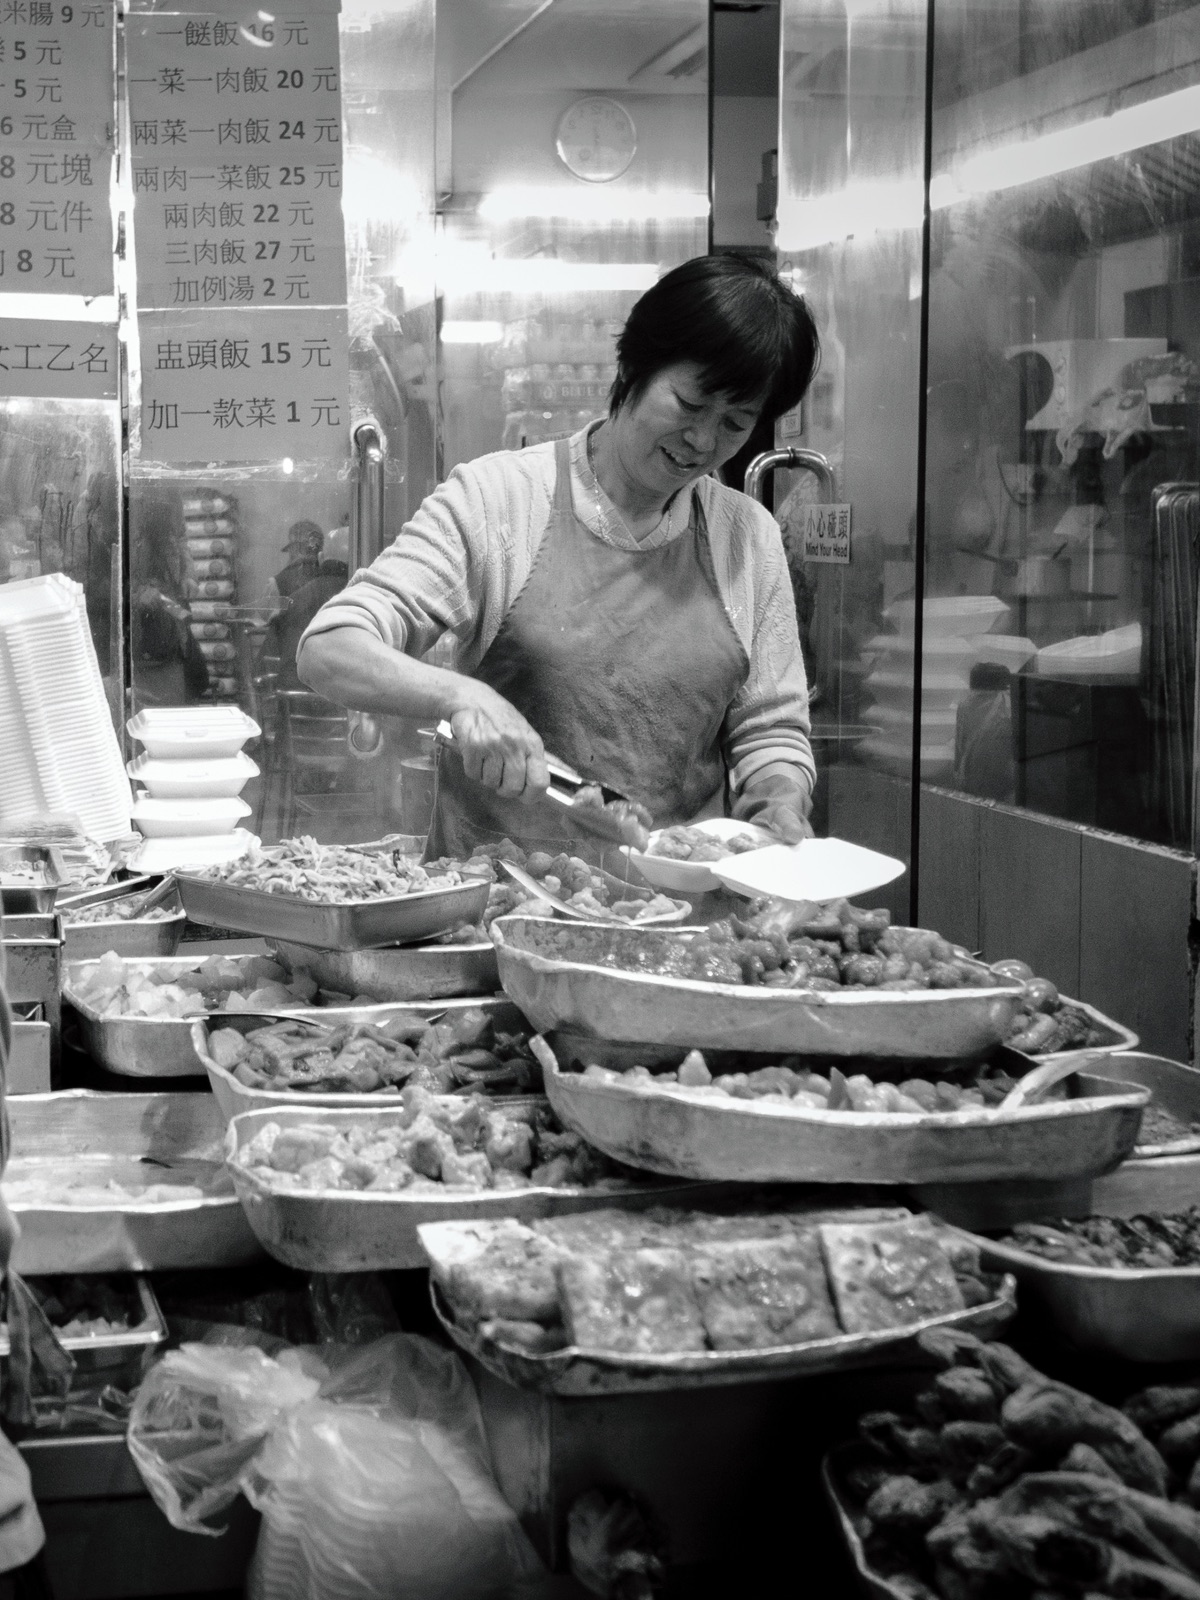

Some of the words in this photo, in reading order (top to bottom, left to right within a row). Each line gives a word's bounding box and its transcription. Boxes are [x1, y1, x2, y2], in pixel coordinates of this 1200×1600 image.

[61, 5, 73, 23] 9
[81, 5, 105, 28] 元
[156, 20, 240, 47] 一餸飯
[282, 20, 309, 47] 元
[14, 41, 26, 61] 5
[36, 39, 62, 66] 元
[14, 79, 26, 98] 5
[36, 77, 62, 103] 元
[130, 66, 270, 95] 一菜一肉飯
[277, 69, 304, 89] 20
[311, 66, 338, 93] 元
[0, 116, 13, 136] 6
[22, 114, 77, 141] 元盒
[132, 118, 271, 146] 兩菜一肉飯
[278, 120, 306, 140] 24
[313, 117, 340, 144] 元
[0, 155, 15, 179] 8
[26, 153, 93, 186] 元塊
[133, 164, 272, 193] 兩肉一菜飯
[279, 167, 306, 186] 25
[314, 163, 340, 190] 元
[0, 202, 15, 225] 8
[26, 200, 93, 233] 元件
[162, 201, 246, 230] 兩肉飯
[253, 204, 280, 223] 22
[288, 200, 314, 227] 元
[17, 249, 33, 273] 8
[44, 248, 76, 279] 元
[165, 238, 247, 266] 三肉飯
[255, 241, 281, 260] 27
[289, 237, 315, 264] 元
[170, 275, 254, 303] 加例湯
[263, 278, 276, 297] 2
[284, 274, 310, 300] 元
[154, 339, 251, 371] 盅頭飯
[261, 342, 292, 365] 15
[301, 338, 332, 369] 元
[147, 398, 277, 431] 加一款菜
[286, 401, 301, 423] 1
[310, 397, 341, 428] 元
[805, 541, 819, 556] Mind
[820, 542, 832, 556] Your
[833, 543, 848, 558] Head
